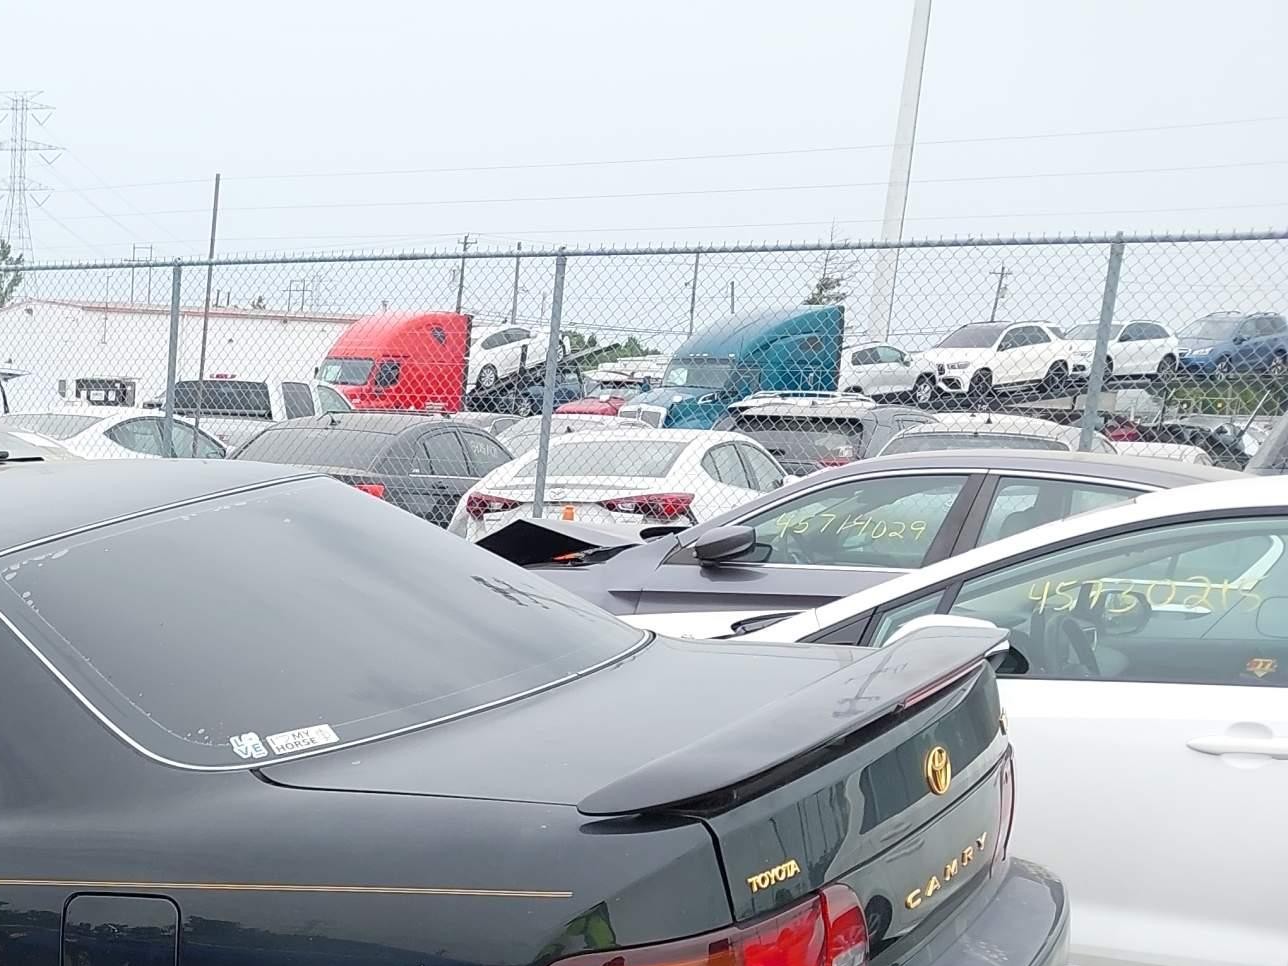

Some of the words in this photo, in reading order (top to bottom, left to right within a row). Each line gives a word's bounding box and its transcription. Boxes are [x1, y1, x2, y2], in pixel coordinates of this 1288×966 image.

[776, 512, 927, 540] 45714029
[274, 737, 318, 753] HORSE
[292, 730, 310, 740] MY
[746, 858, 801, 893] TOYOTA
[904, 831, 989, 909] CAMRY
